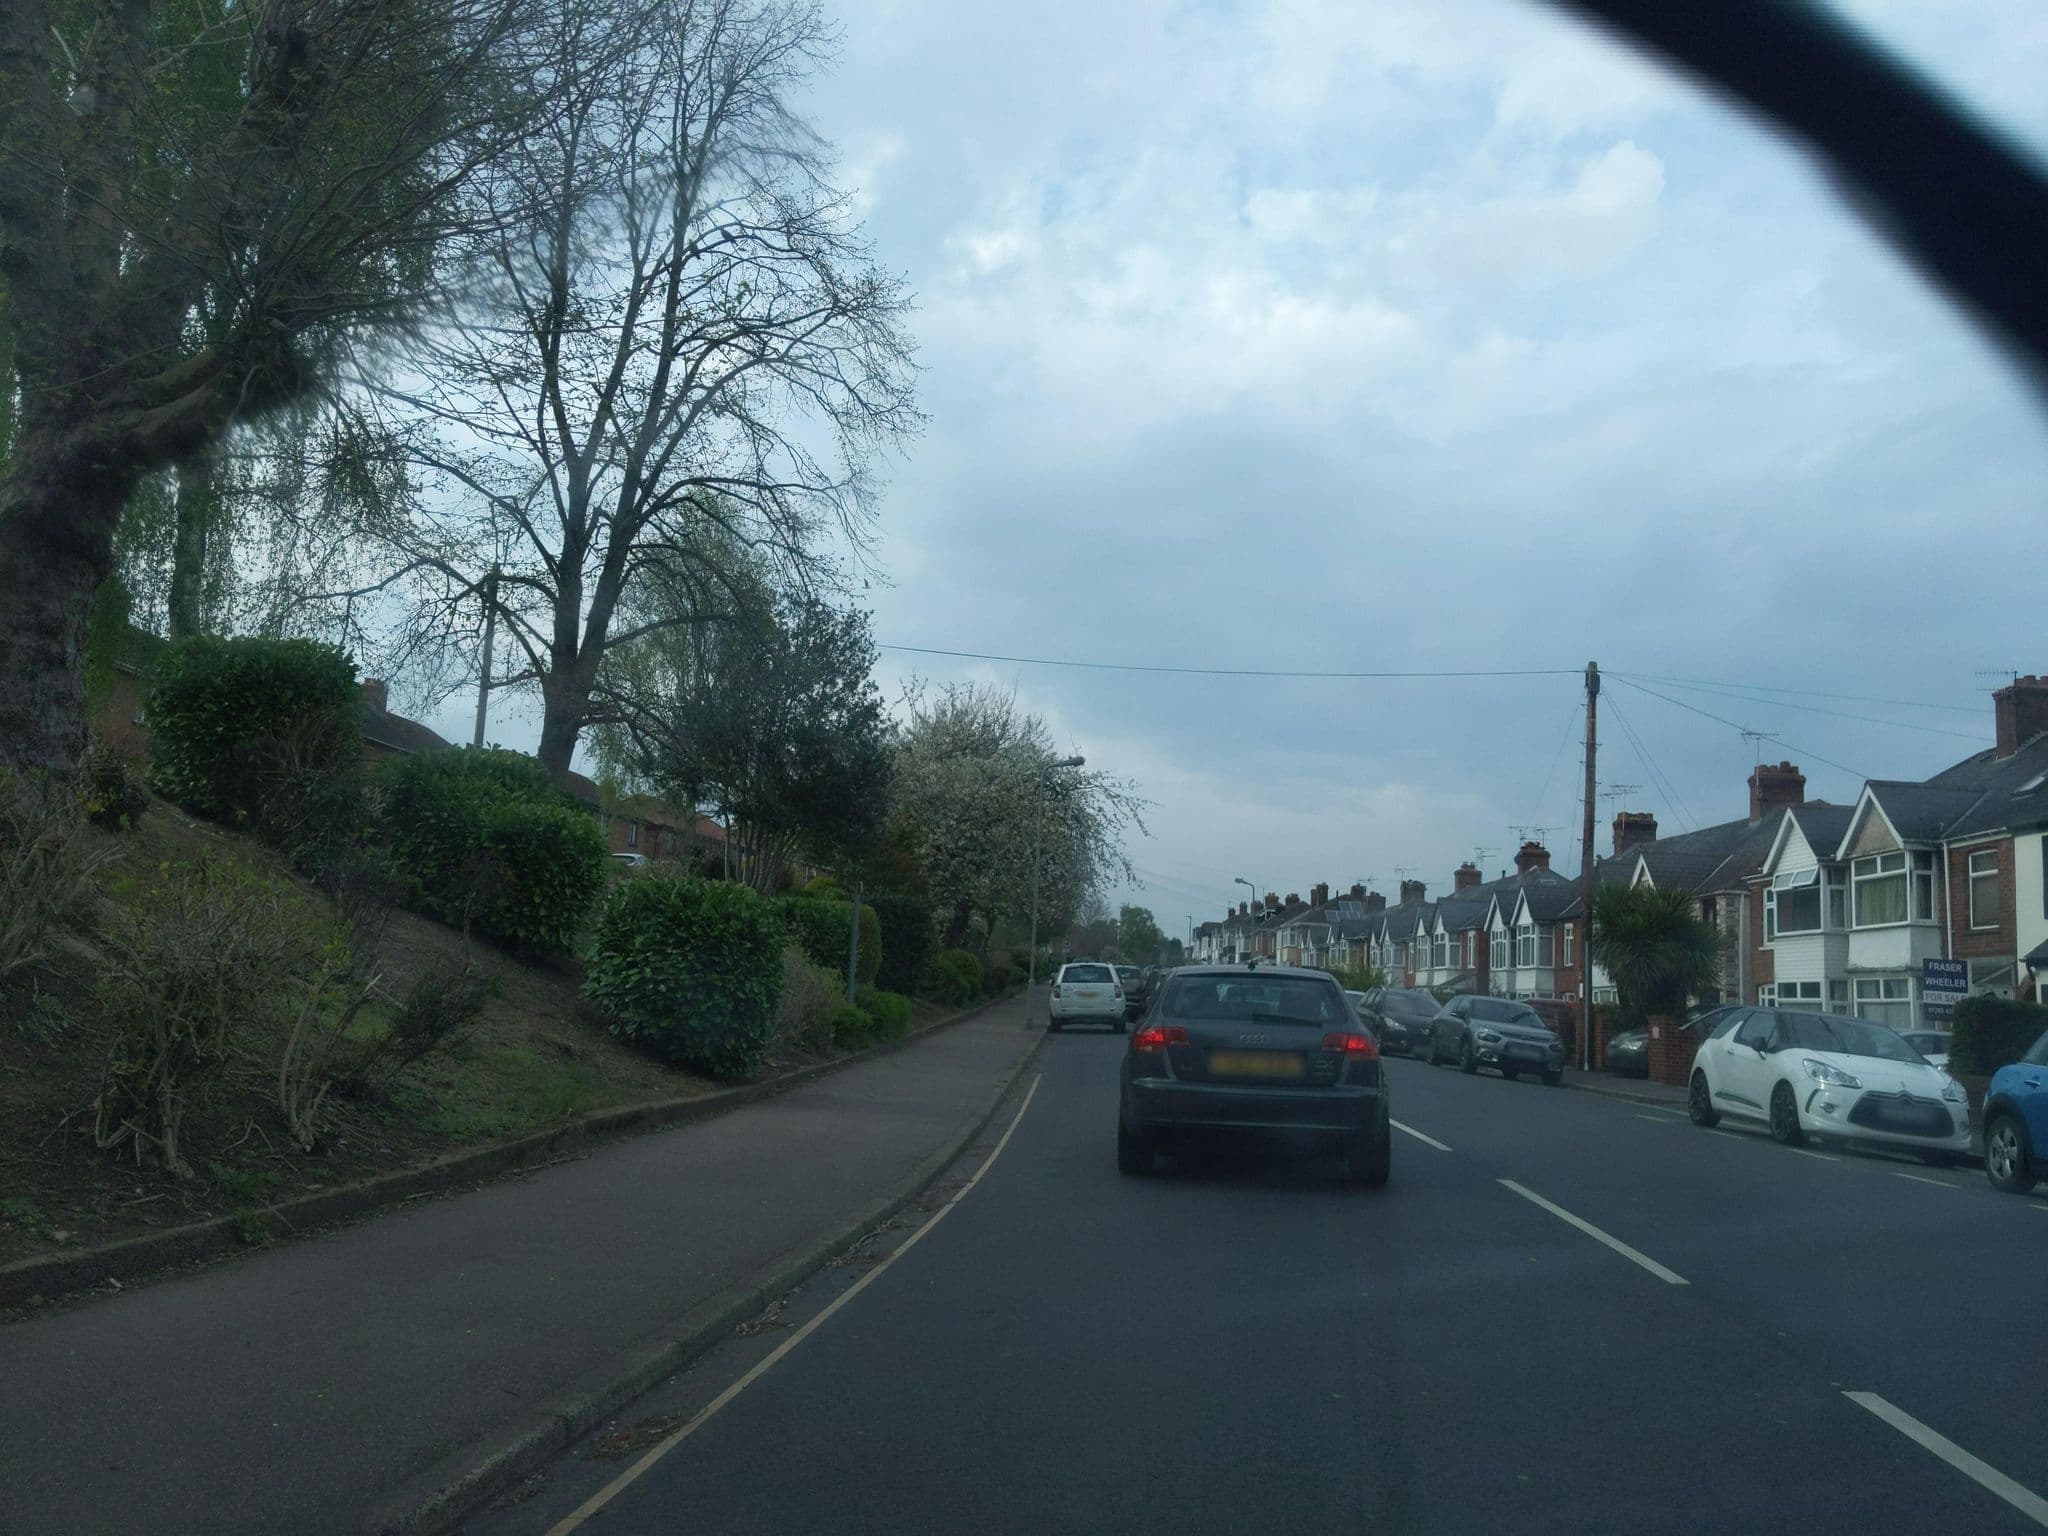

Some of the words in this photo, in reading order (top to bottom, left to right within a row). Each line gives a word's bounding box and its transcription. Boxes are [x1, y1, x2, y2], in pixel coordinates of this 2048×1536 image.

[1928, 961, 1962, 972] FRASER
[1925, 977, 1966, 988] WHEELER
[1926, 992, 1942, 1001] FOR
